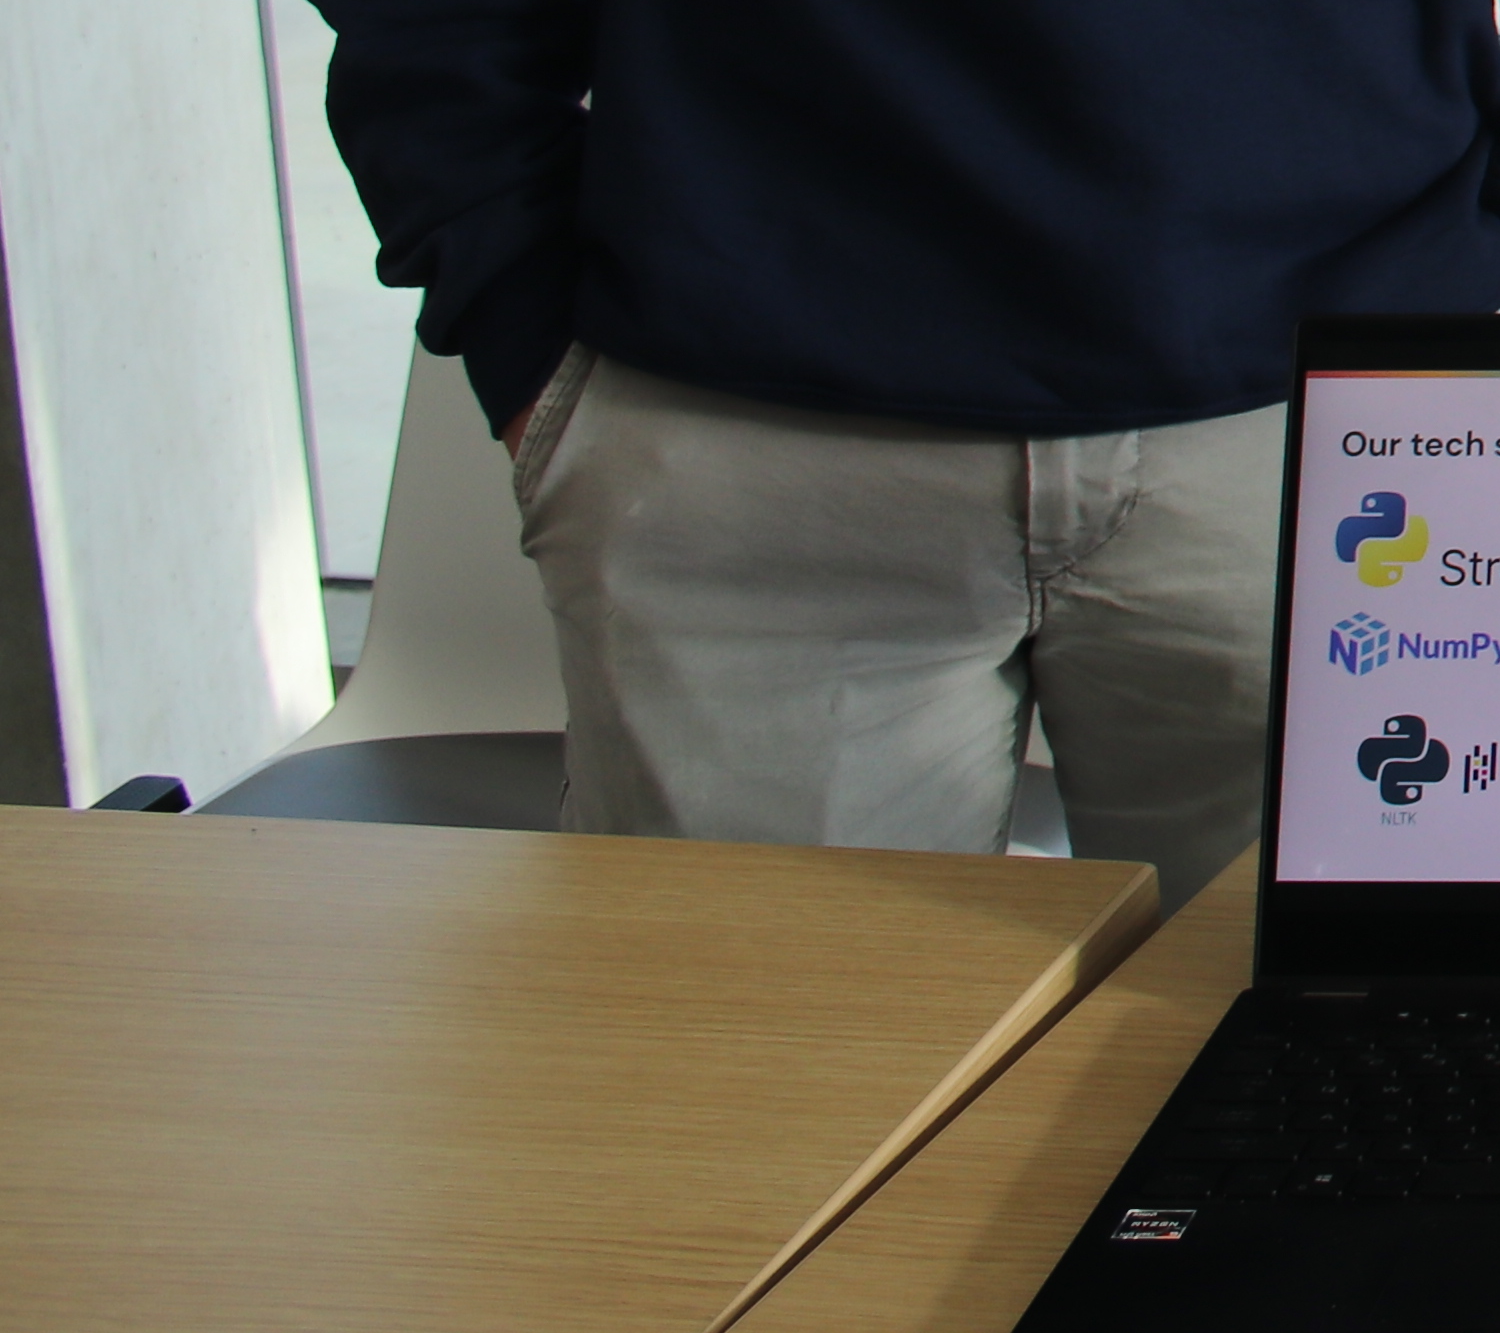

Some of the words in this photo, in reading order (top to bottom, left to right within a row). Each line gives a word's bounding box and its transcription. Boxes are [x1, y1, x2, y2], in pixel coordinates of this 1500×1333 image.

[1342, 431, 1400, 456] Our
[1412, 431, 1483, 456] tech
[1381, 812, 1417, 826] NLTK
